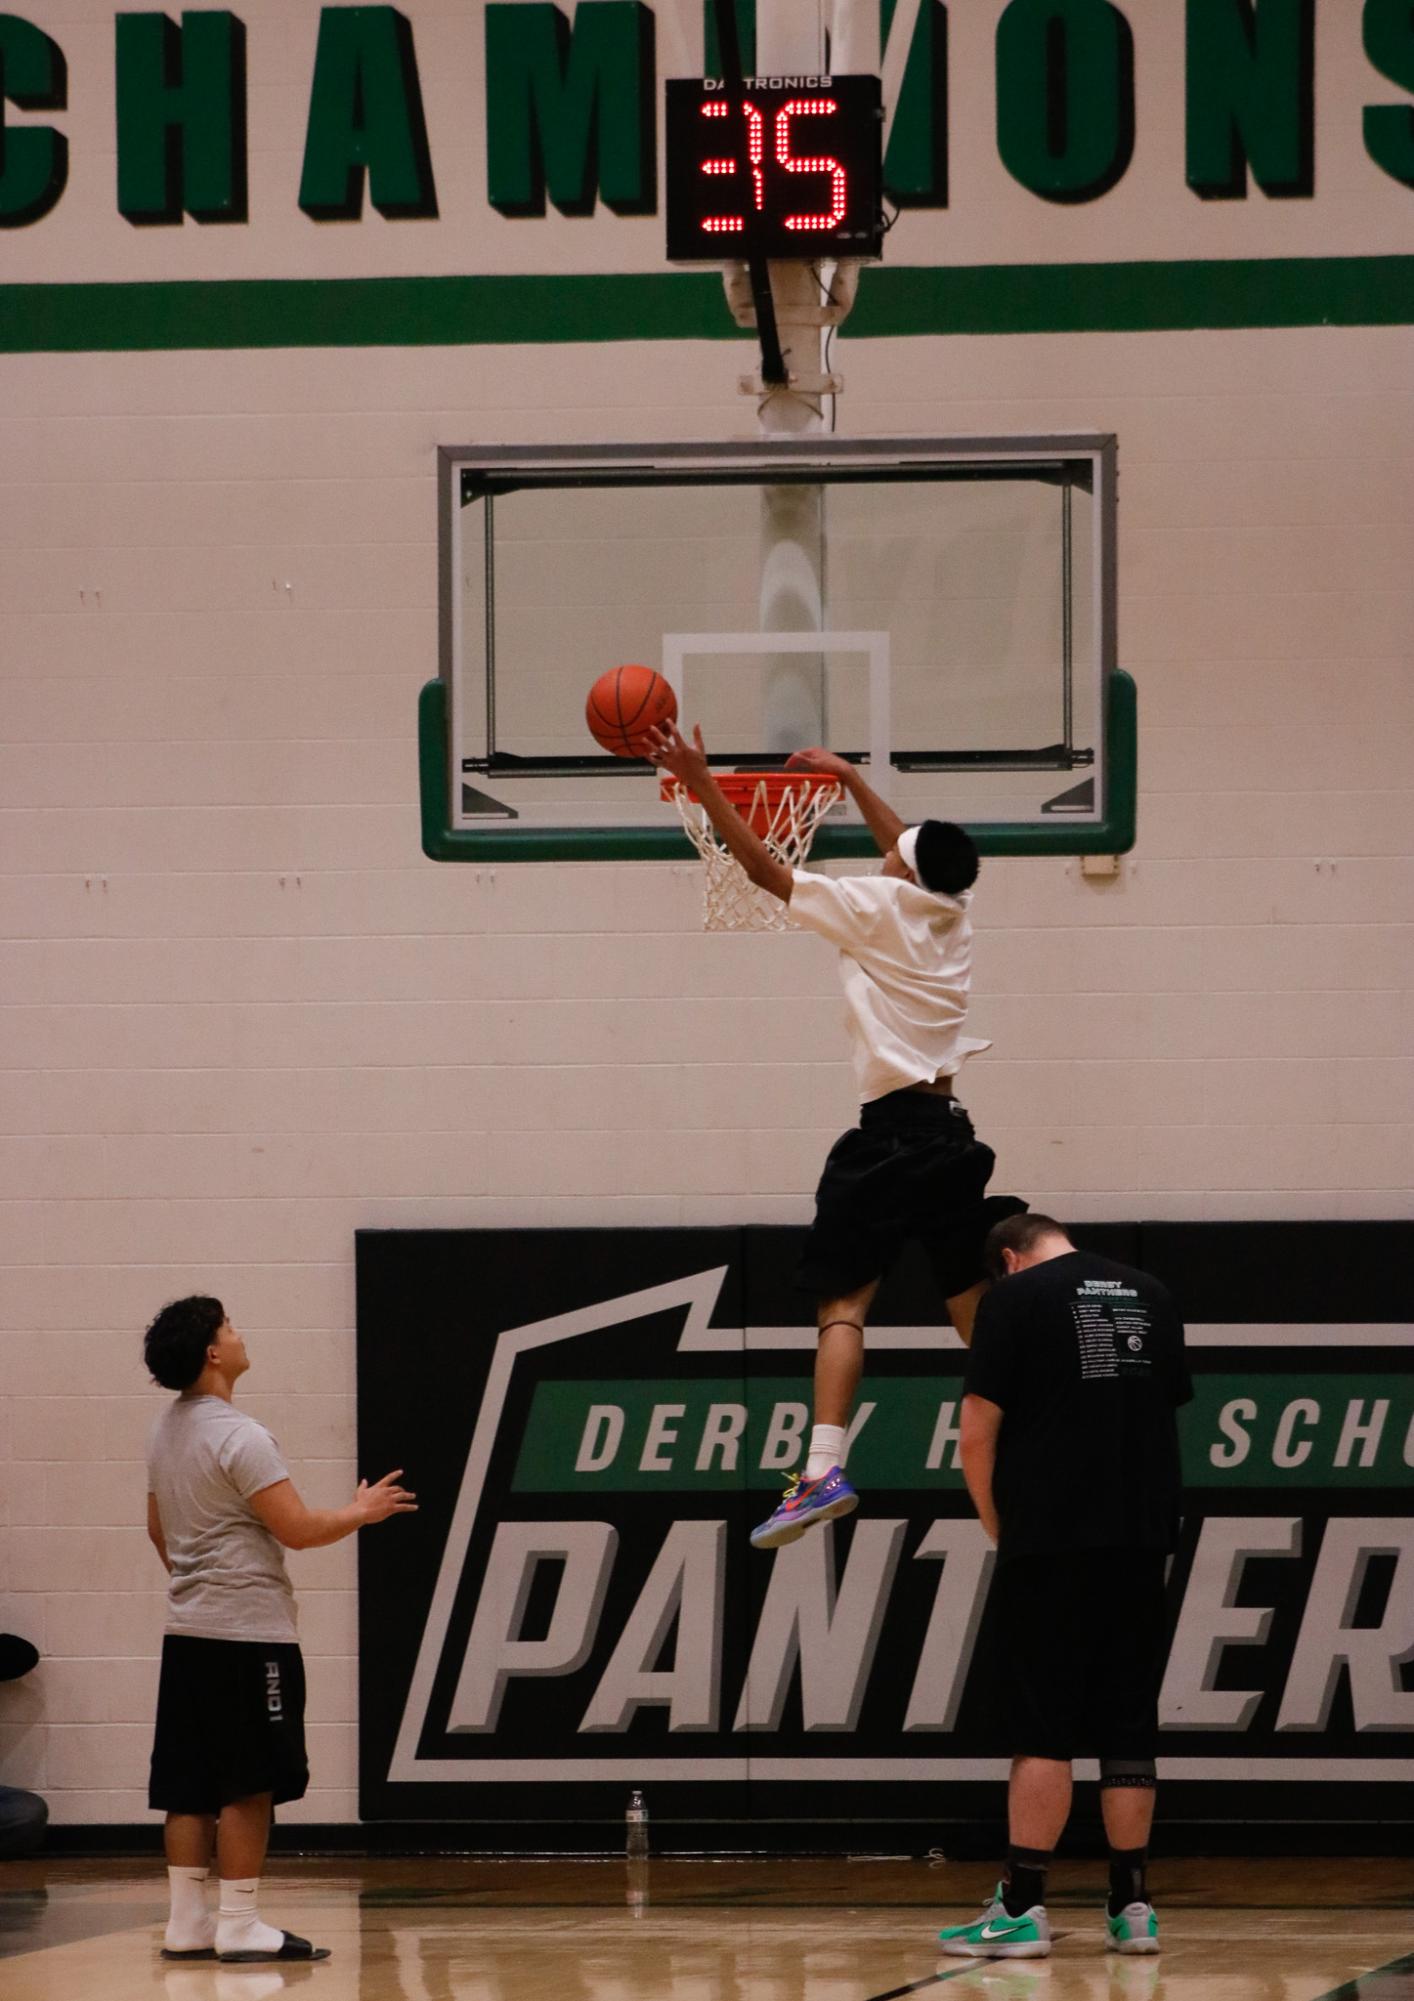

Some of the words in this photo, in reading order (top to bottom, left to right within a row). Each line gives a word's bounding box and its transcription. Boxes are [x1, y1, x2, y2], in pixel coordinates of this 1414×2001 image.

[0, 0, 1414, 228] HAMION
[703, 76, 833, 90] DATRONICS
[1209, 1398, 1414, 1468] SCH
[446, 1516, 1414, 1733] PANTER
